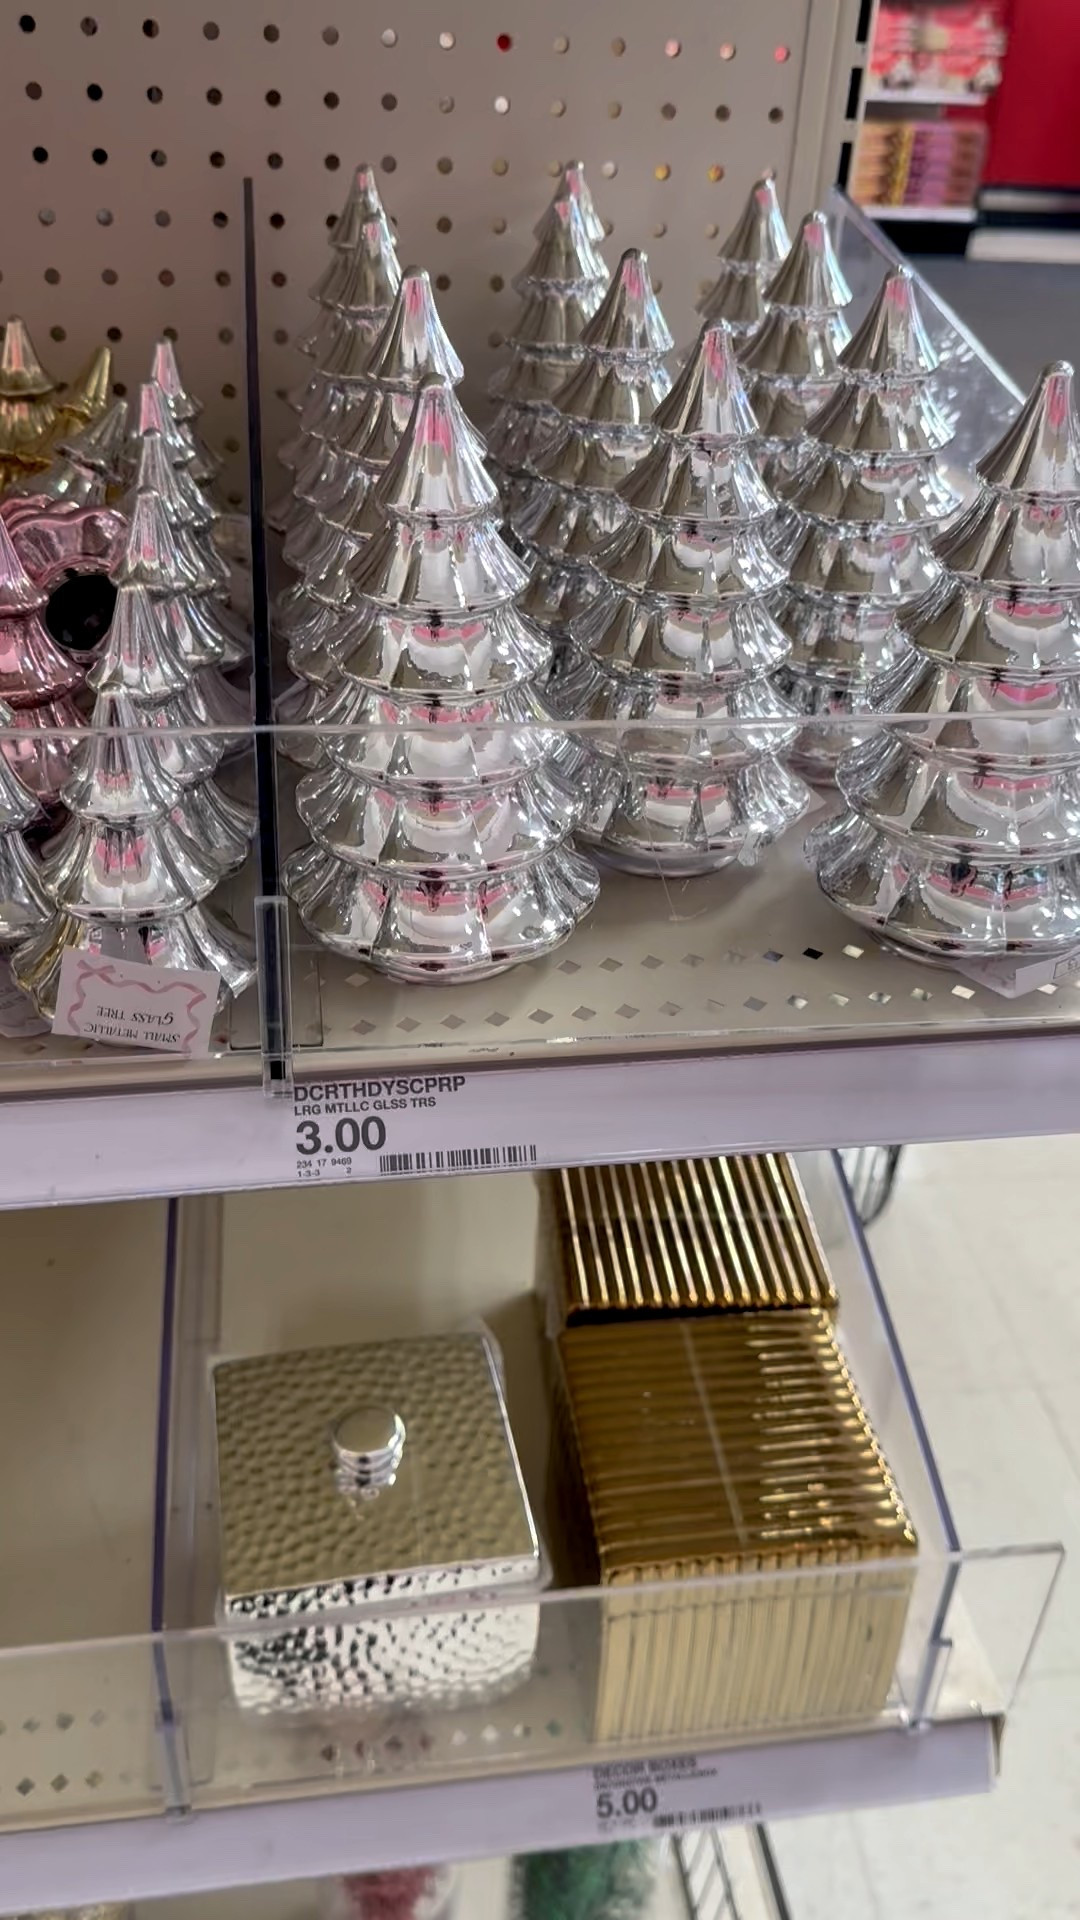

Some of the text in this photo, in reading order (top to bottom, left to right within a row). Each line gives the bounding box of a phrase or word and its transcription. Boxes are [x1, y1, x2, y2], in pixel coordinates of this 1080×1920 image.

[96, 1005, 174, 1026] GLASS TREE
[83, 1022, 181, 1043] SMALL METALLIC
[294, 1075, 466, 1102] DCRTHDYSCPRP
[294, 1096, 437, 1116] LRG MTLLC GLSS TRS
[296, 1115, 387, 1155] 3.00
[597, 1786, 658, 1819] 5.00
